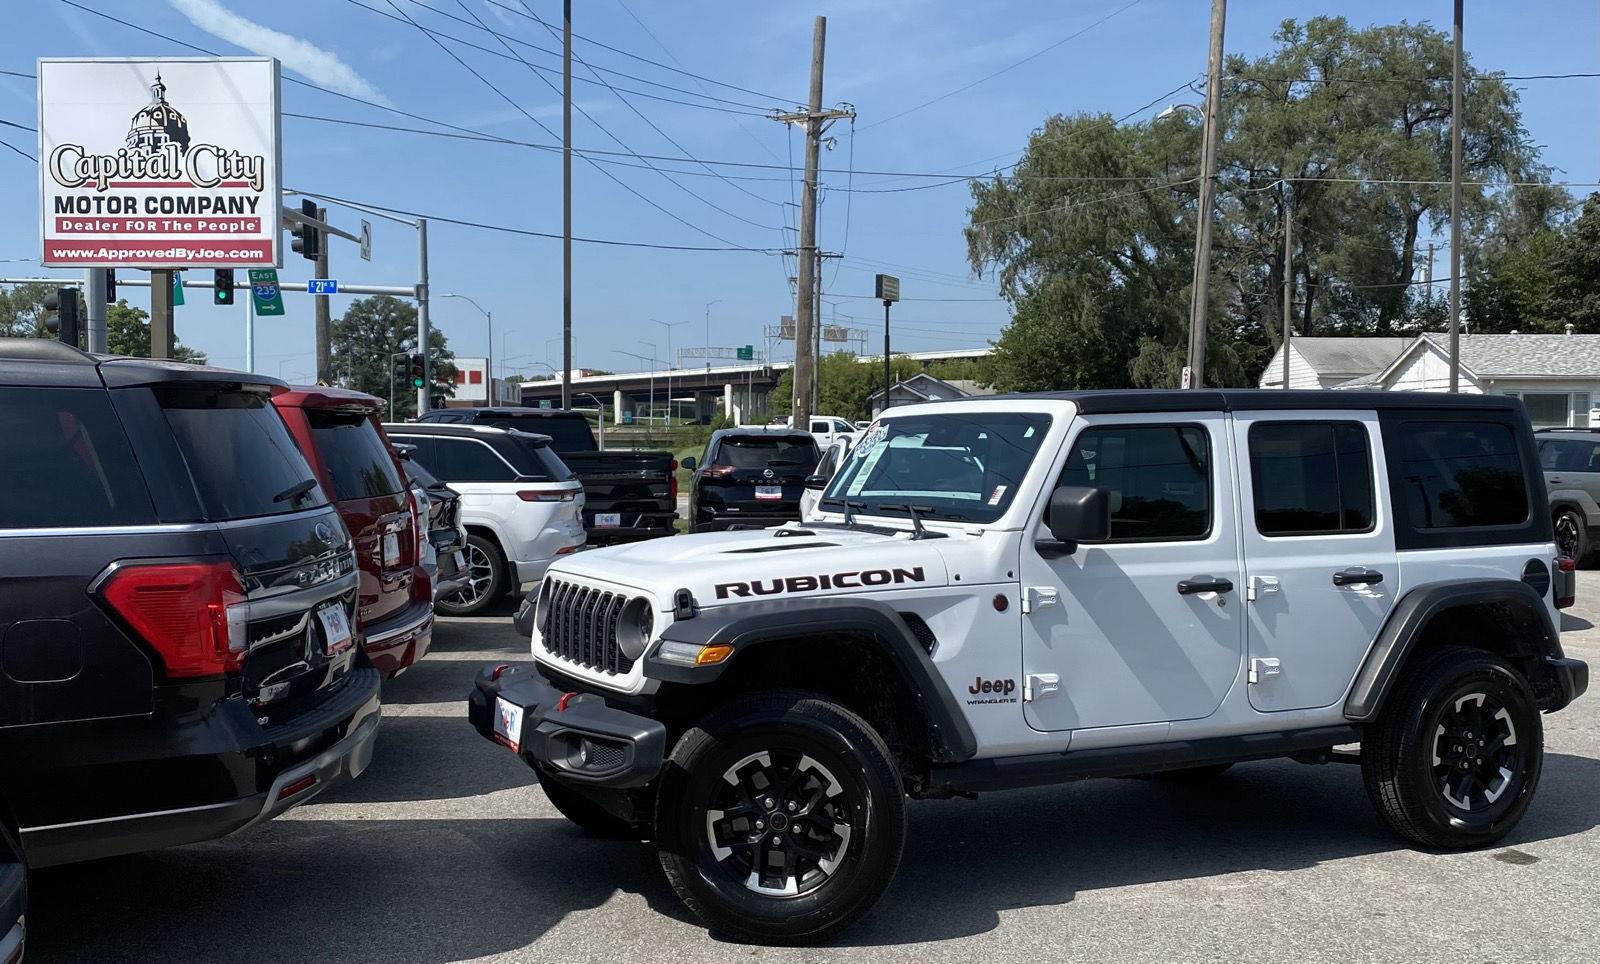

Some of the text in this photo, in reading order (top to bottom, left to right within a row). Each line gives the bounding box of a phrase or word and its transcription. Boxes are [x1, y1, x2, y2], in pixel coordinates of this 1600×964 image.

[49, 143, 265, 192] Capital City
[54, 195, 260, 214] MOTOR COMPANY
[62, 220, 119, 231] Dealer
[126, 220, 157, 231] FOR
[162, 220, 192, 231] The
[52, 247, 263, 260] www.ApprovedByJoe.com
[256, 286, 276, 295] 235
[714, 566, 926, 599] RUBICON
[968, 676, 1015, 695] Jeep
